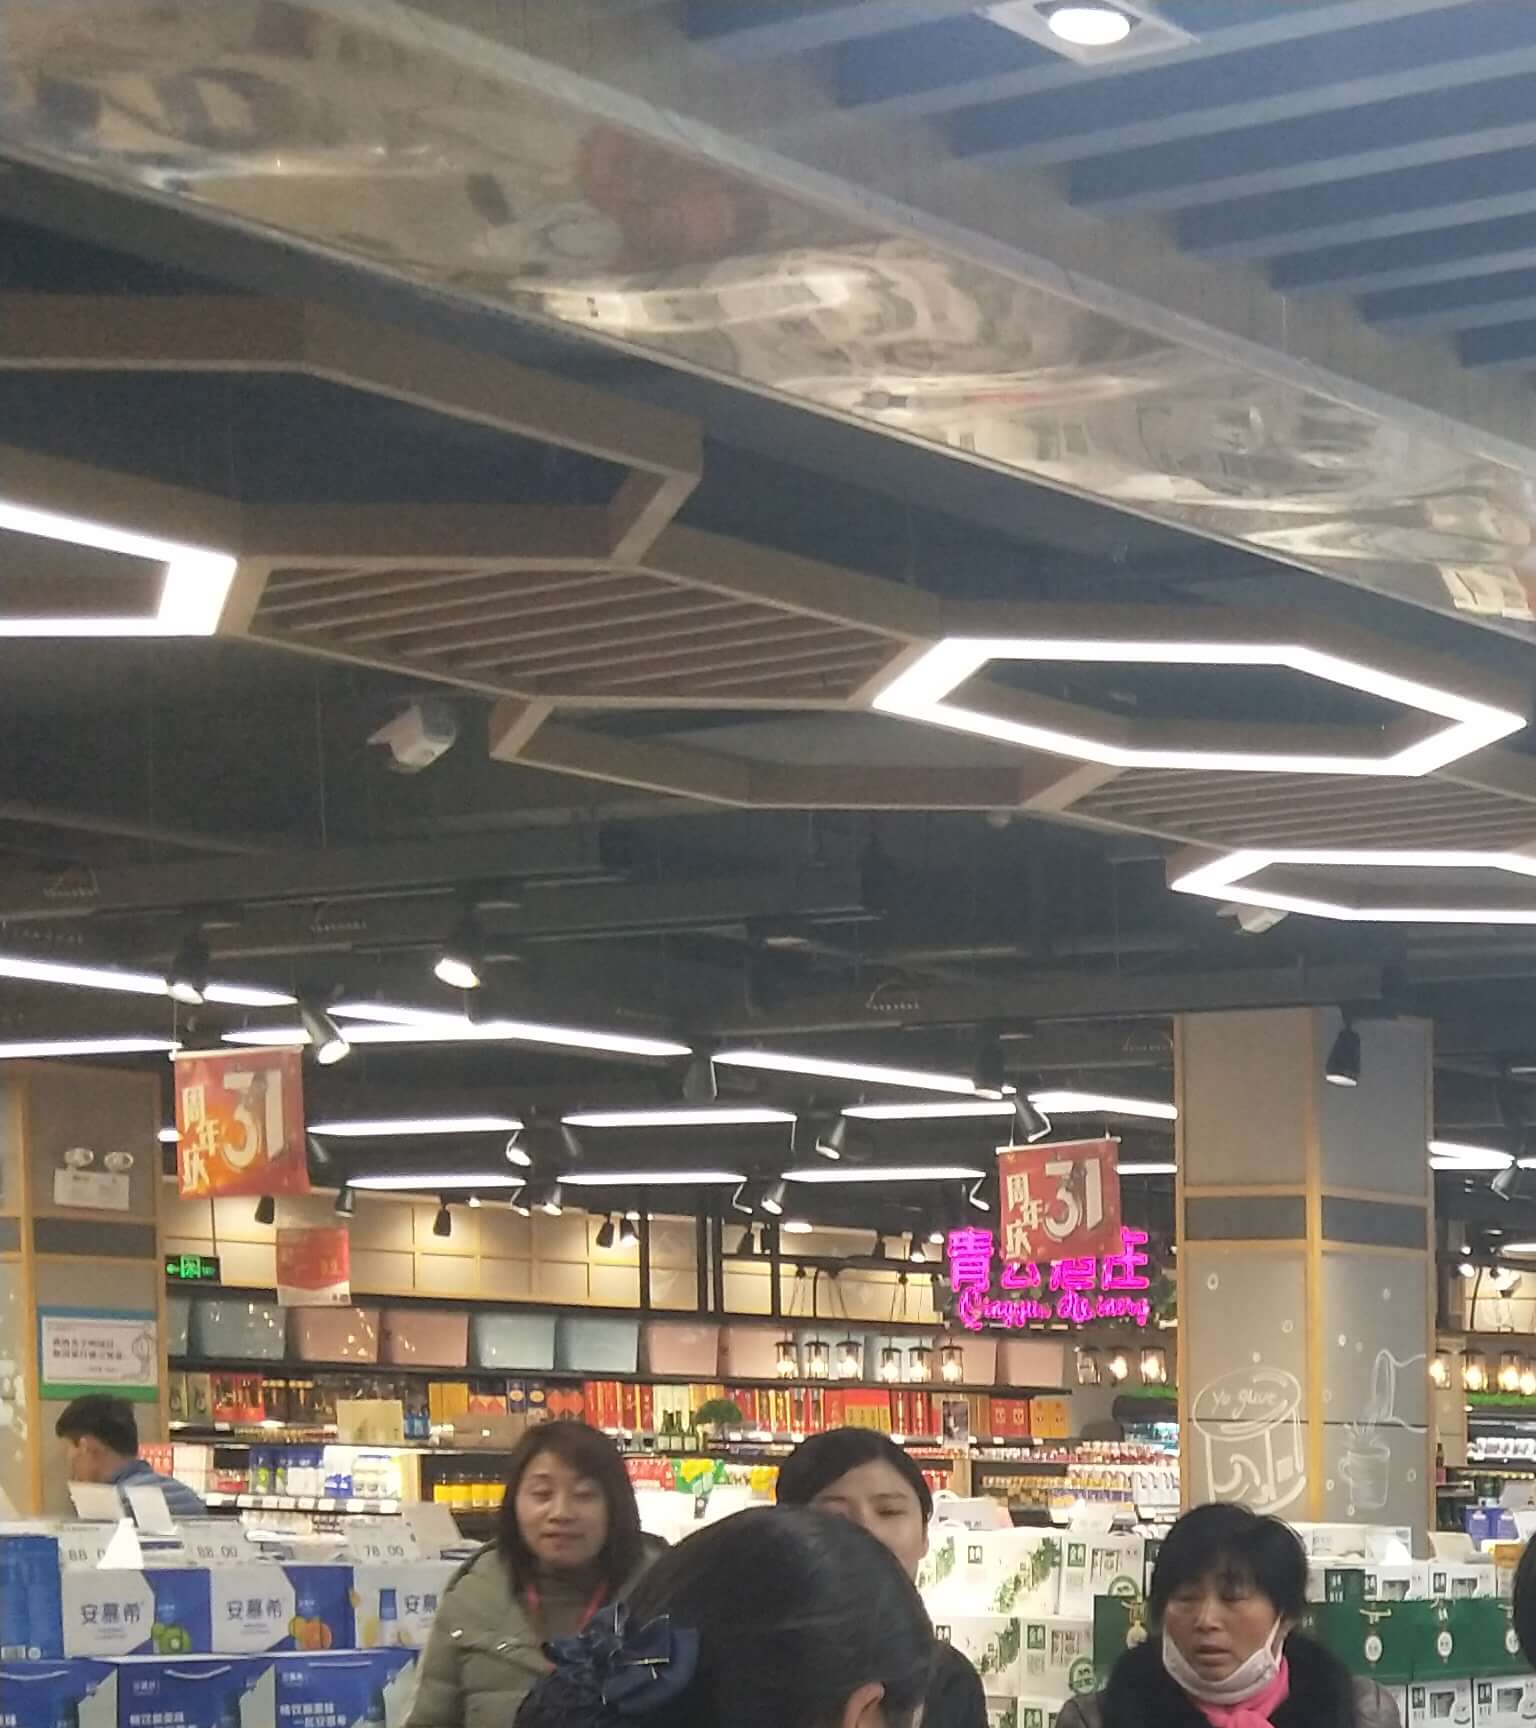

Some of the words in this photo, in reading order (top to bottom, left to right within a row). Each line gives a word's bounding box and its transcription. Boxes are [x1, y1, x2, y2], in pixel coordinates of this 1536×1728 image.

[223, 1070, 285, 1170] 31
[1045, 1158, 1103, 1240] 31
[80, 1601, 141, 1625] 安慕希
[226, 1597, 283, 1621] 安慕希
[404, 1593, 438, 1616] 安慕
